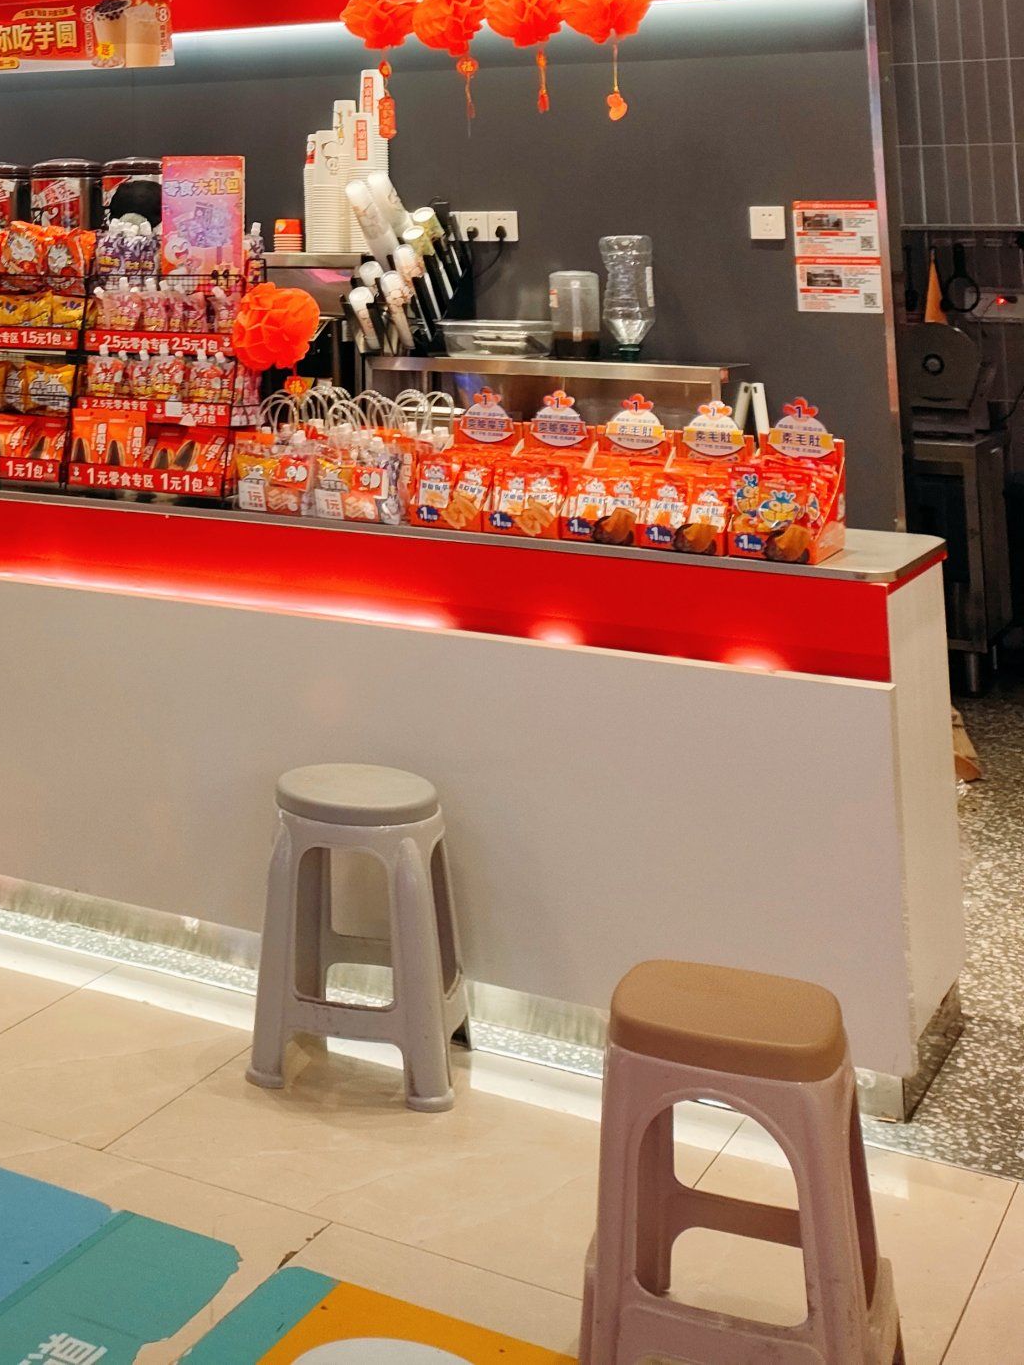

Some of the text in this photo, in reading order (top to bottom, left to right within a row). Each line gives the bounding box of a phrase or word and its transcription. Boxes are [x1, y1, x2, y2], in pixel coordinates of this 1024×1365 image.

[163, 177, 241, 197] 零食大礼包
[21, 331, 62, 346] 1.5元1包
[6, 460, 44, 478] 1元1包
[87, 467, 204, 493] 1元零食专区 1元1包
